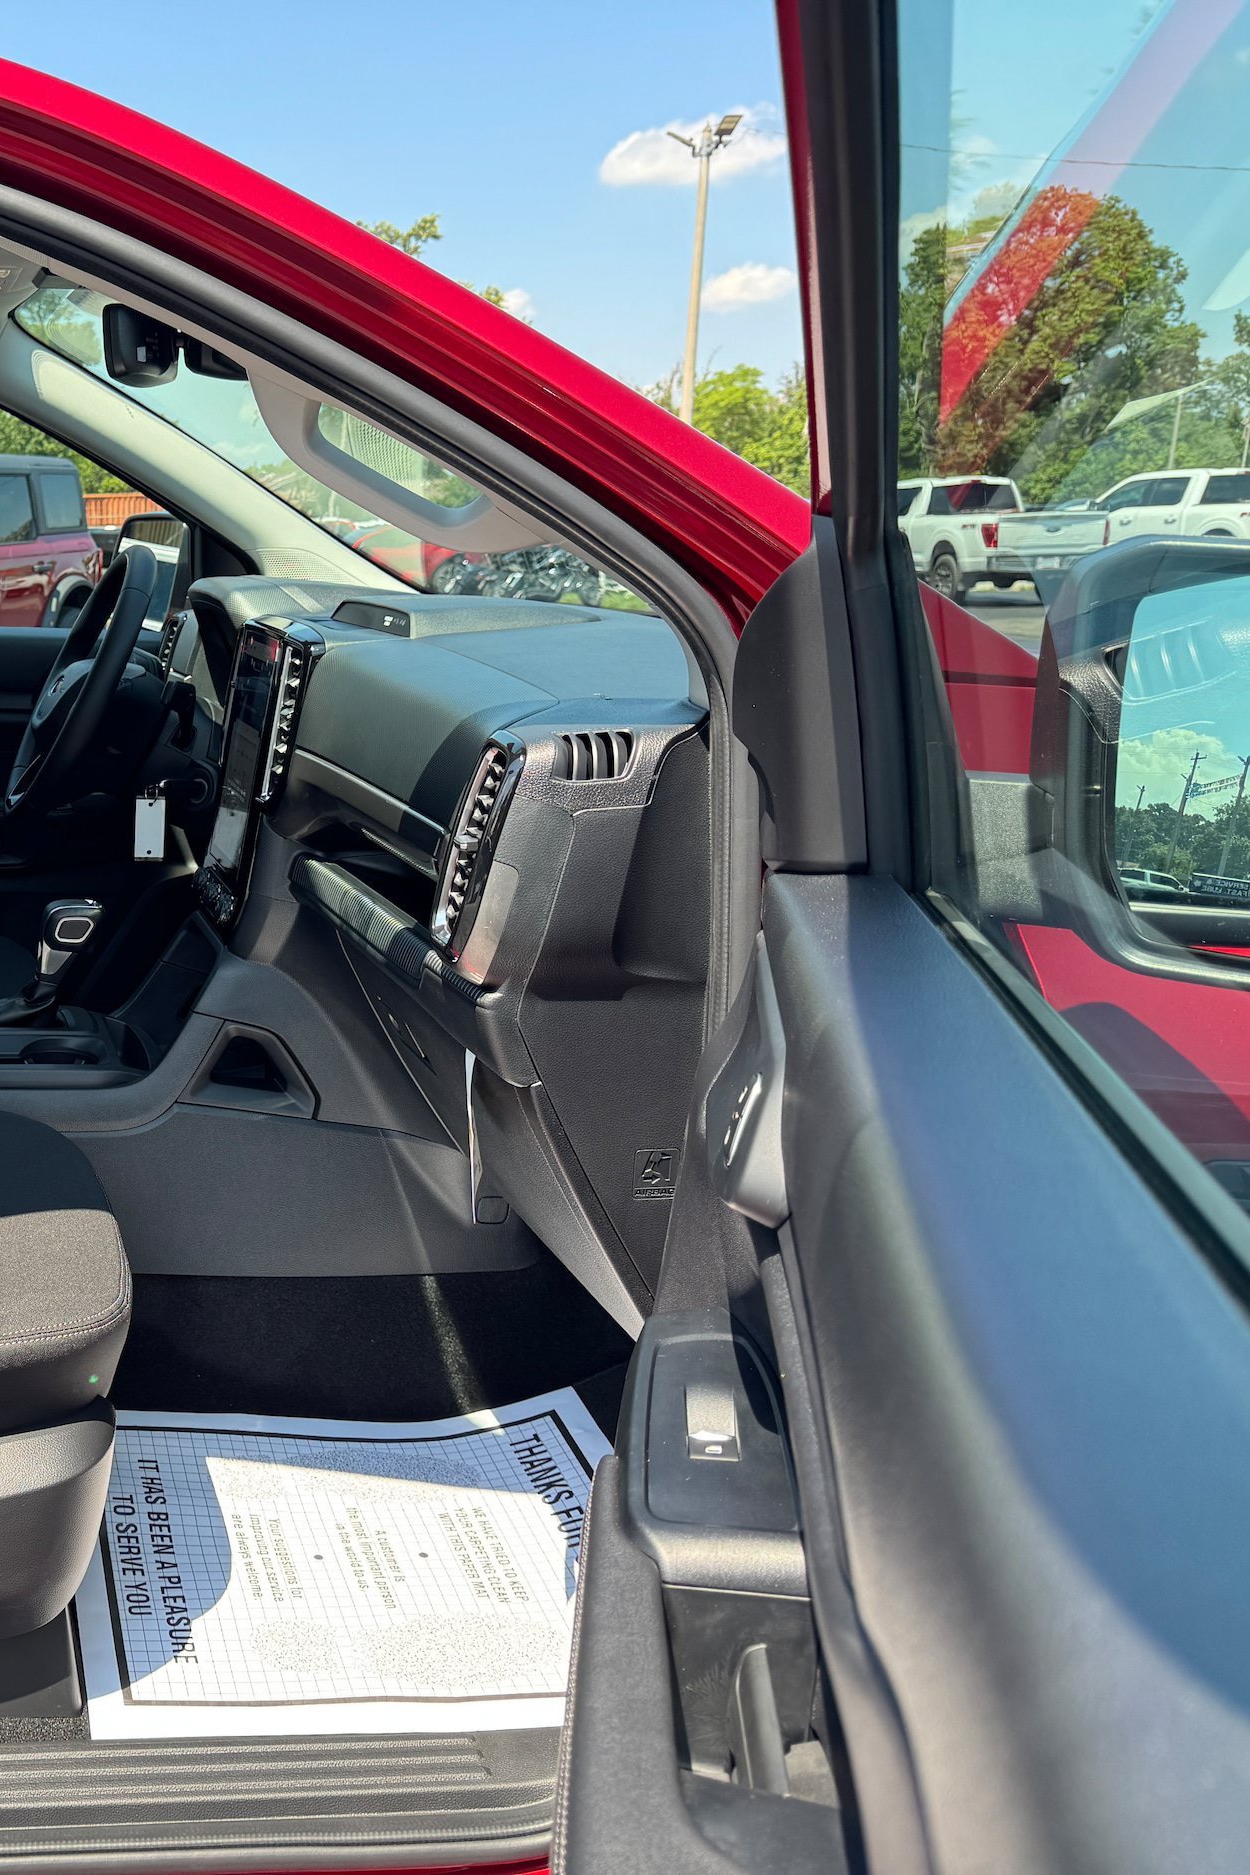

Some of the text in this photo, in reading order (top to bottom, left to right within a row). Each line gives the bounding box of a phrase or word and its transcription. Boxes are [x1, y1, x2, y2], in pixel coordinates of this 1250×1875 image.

[510, 1433, 575, 1505] THANKS
[112, 1494, 152, 1616] TO SERVE YOU
[138, 1459, 199, 1664] IT HAS BEEN A PLEASURE
[232, 1514, 263, 1600] are always welcome.
[249, 1514, 284, 1602] improving our service
[268, 1518, 303, 1599] Your suggestions for
[339, 1532, 351, 1544] the
[345, 1546, 363, 1567] world
[346, 1507, 396, 1609] the most important person
[353, 1569, 364, 1578] to
[377, 1537, 402, 1573] customer
[438, 1513, 490, 1599] WITH THIS PAPER MAT
[454, 1507, 511, 1603] YOUR CARPETING CLEAN
[472, 1507, 529, 1602] WE HAVE TRIED TO KEEP
